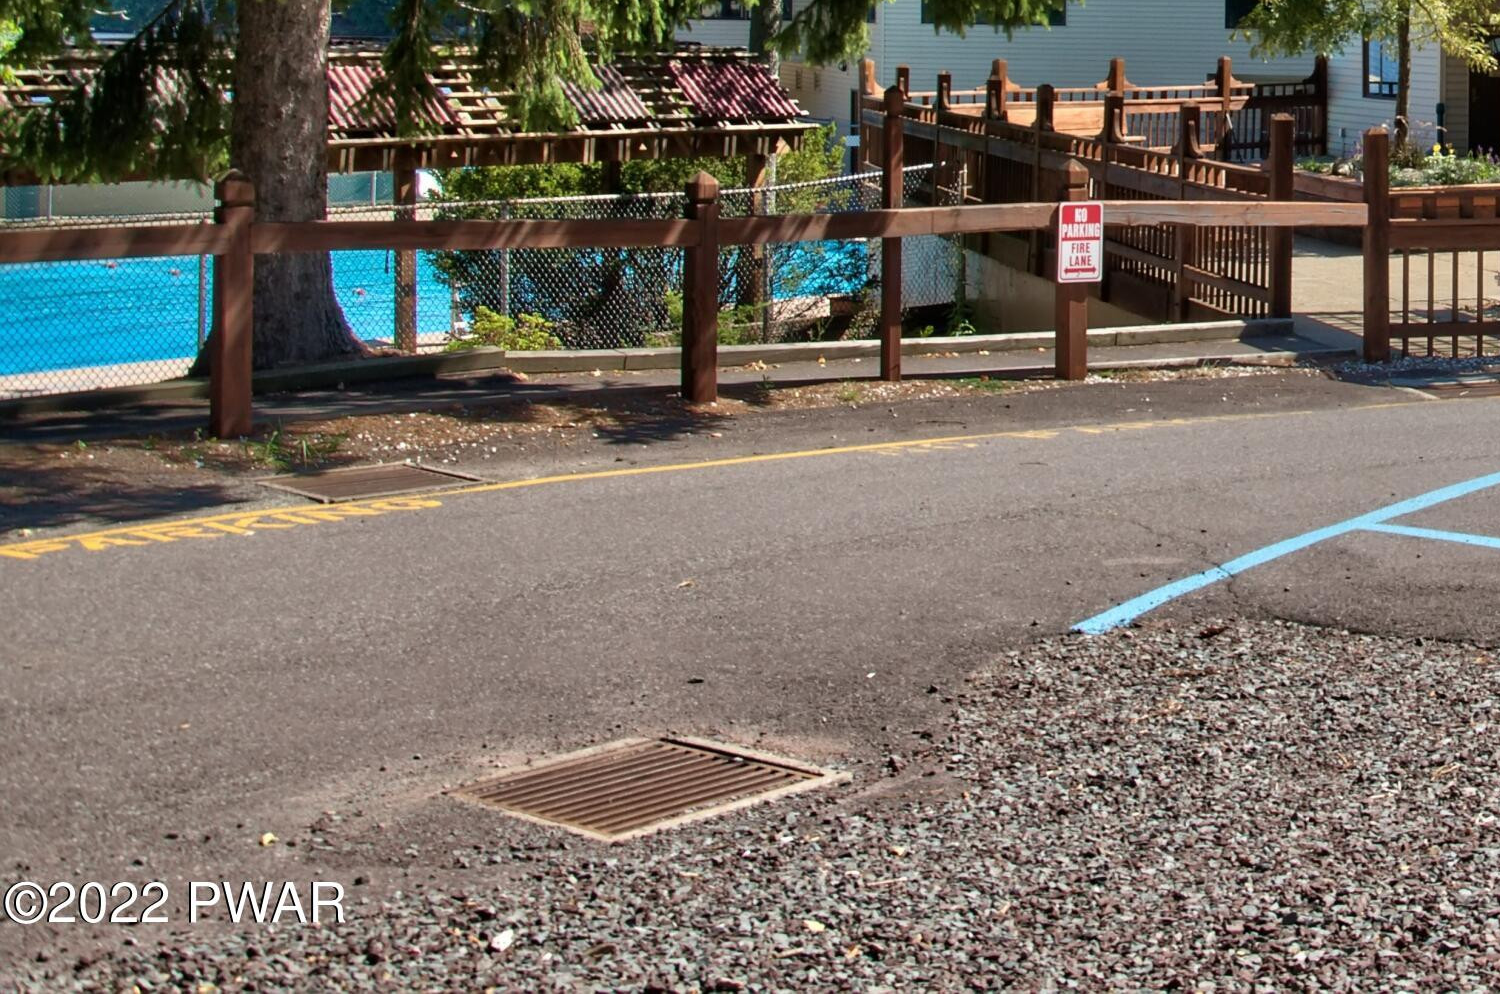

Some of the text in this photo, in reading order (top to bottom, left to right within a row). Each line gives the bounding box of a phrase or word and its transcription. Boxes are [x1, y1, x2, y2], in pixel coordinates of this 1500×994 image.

[1074, 208, 1087, 222] NO
[1062, 223, 1100, 238] PARKING
[1071, 242, 1091, 253] FIRE
[1069, 255, 1092, 267] LANE
